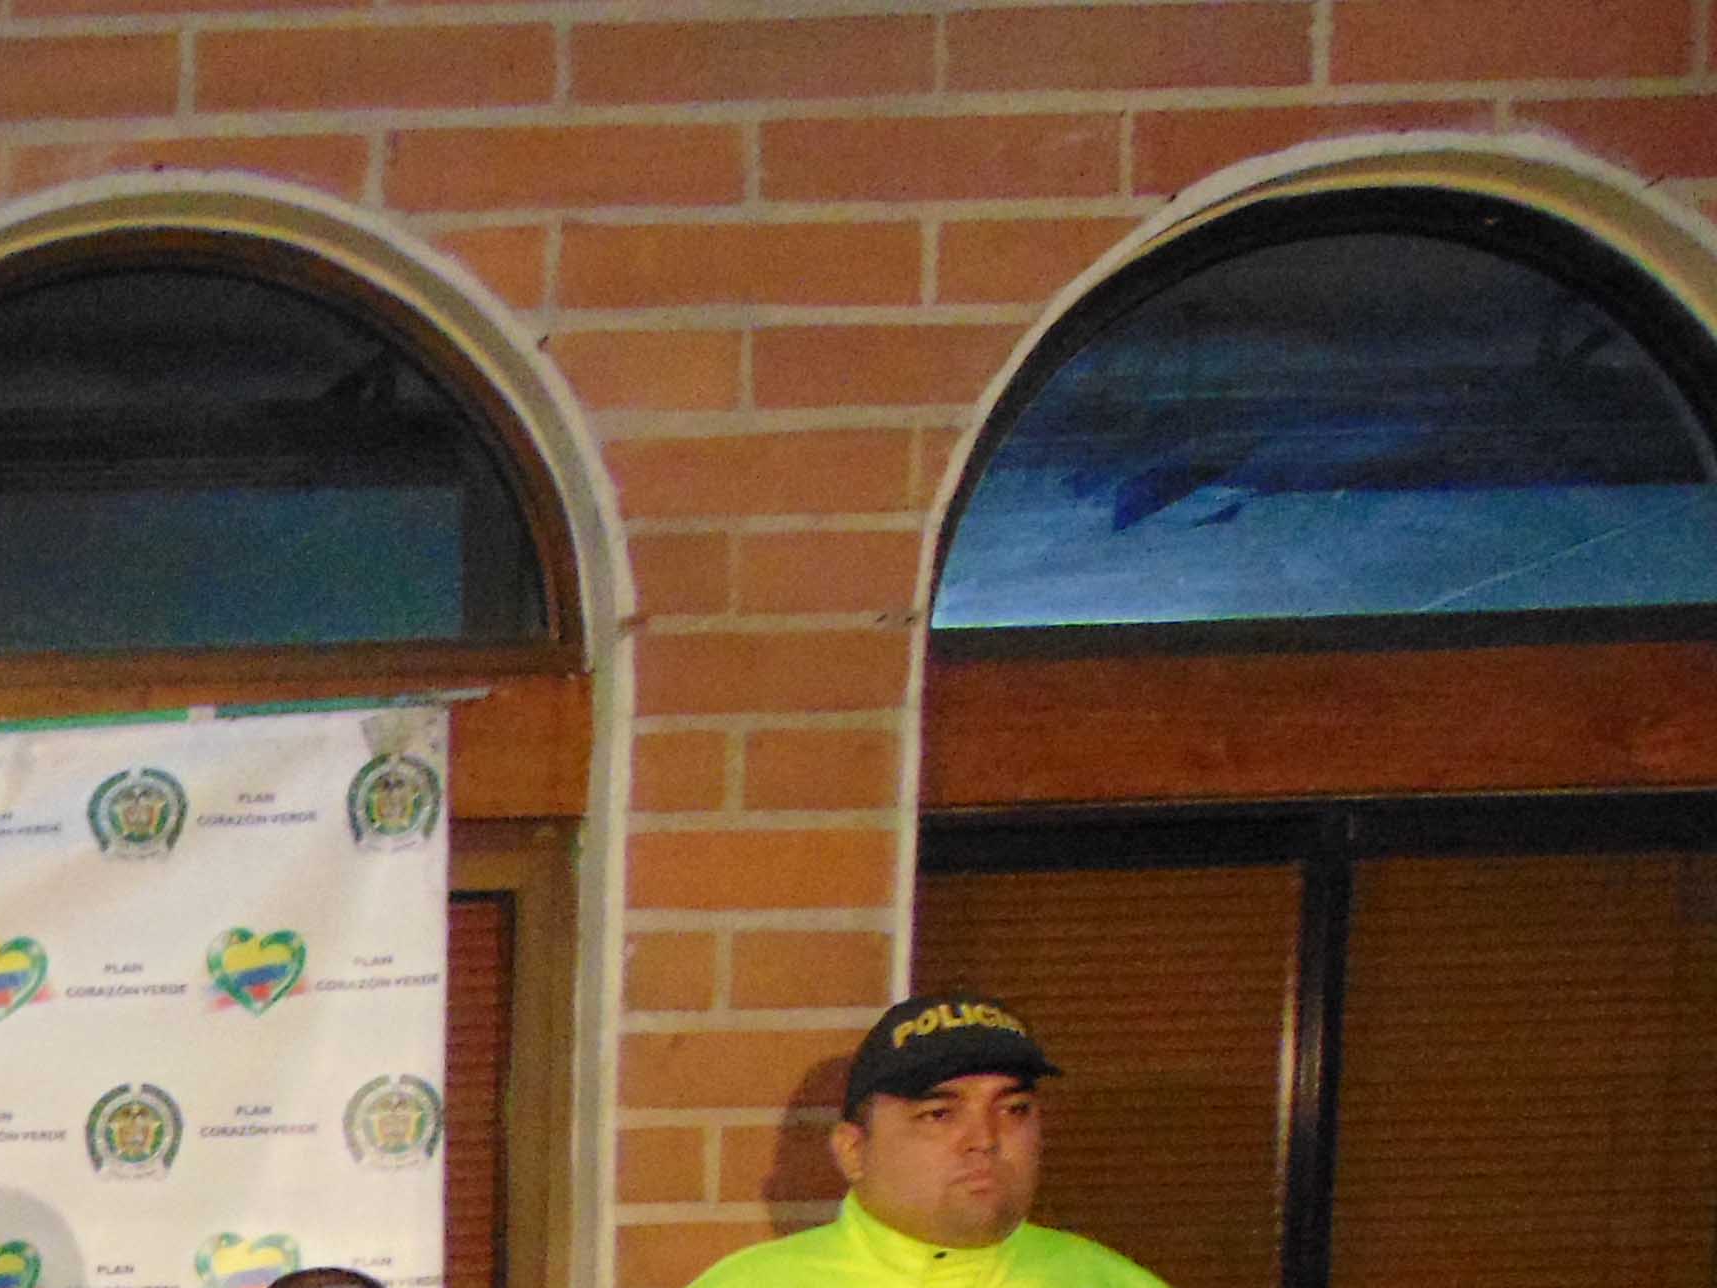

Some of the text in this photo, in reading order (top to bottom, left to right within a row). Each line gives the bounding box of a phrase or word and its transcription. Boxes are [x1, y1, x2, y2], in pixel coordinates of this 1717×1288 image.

[103, 961, 145, 975] PLAN
[352, 954, 394, 969] PLAN
[143, 981, 188, 997] VERDE
[96, 1264, 135, 1277] PLAN
